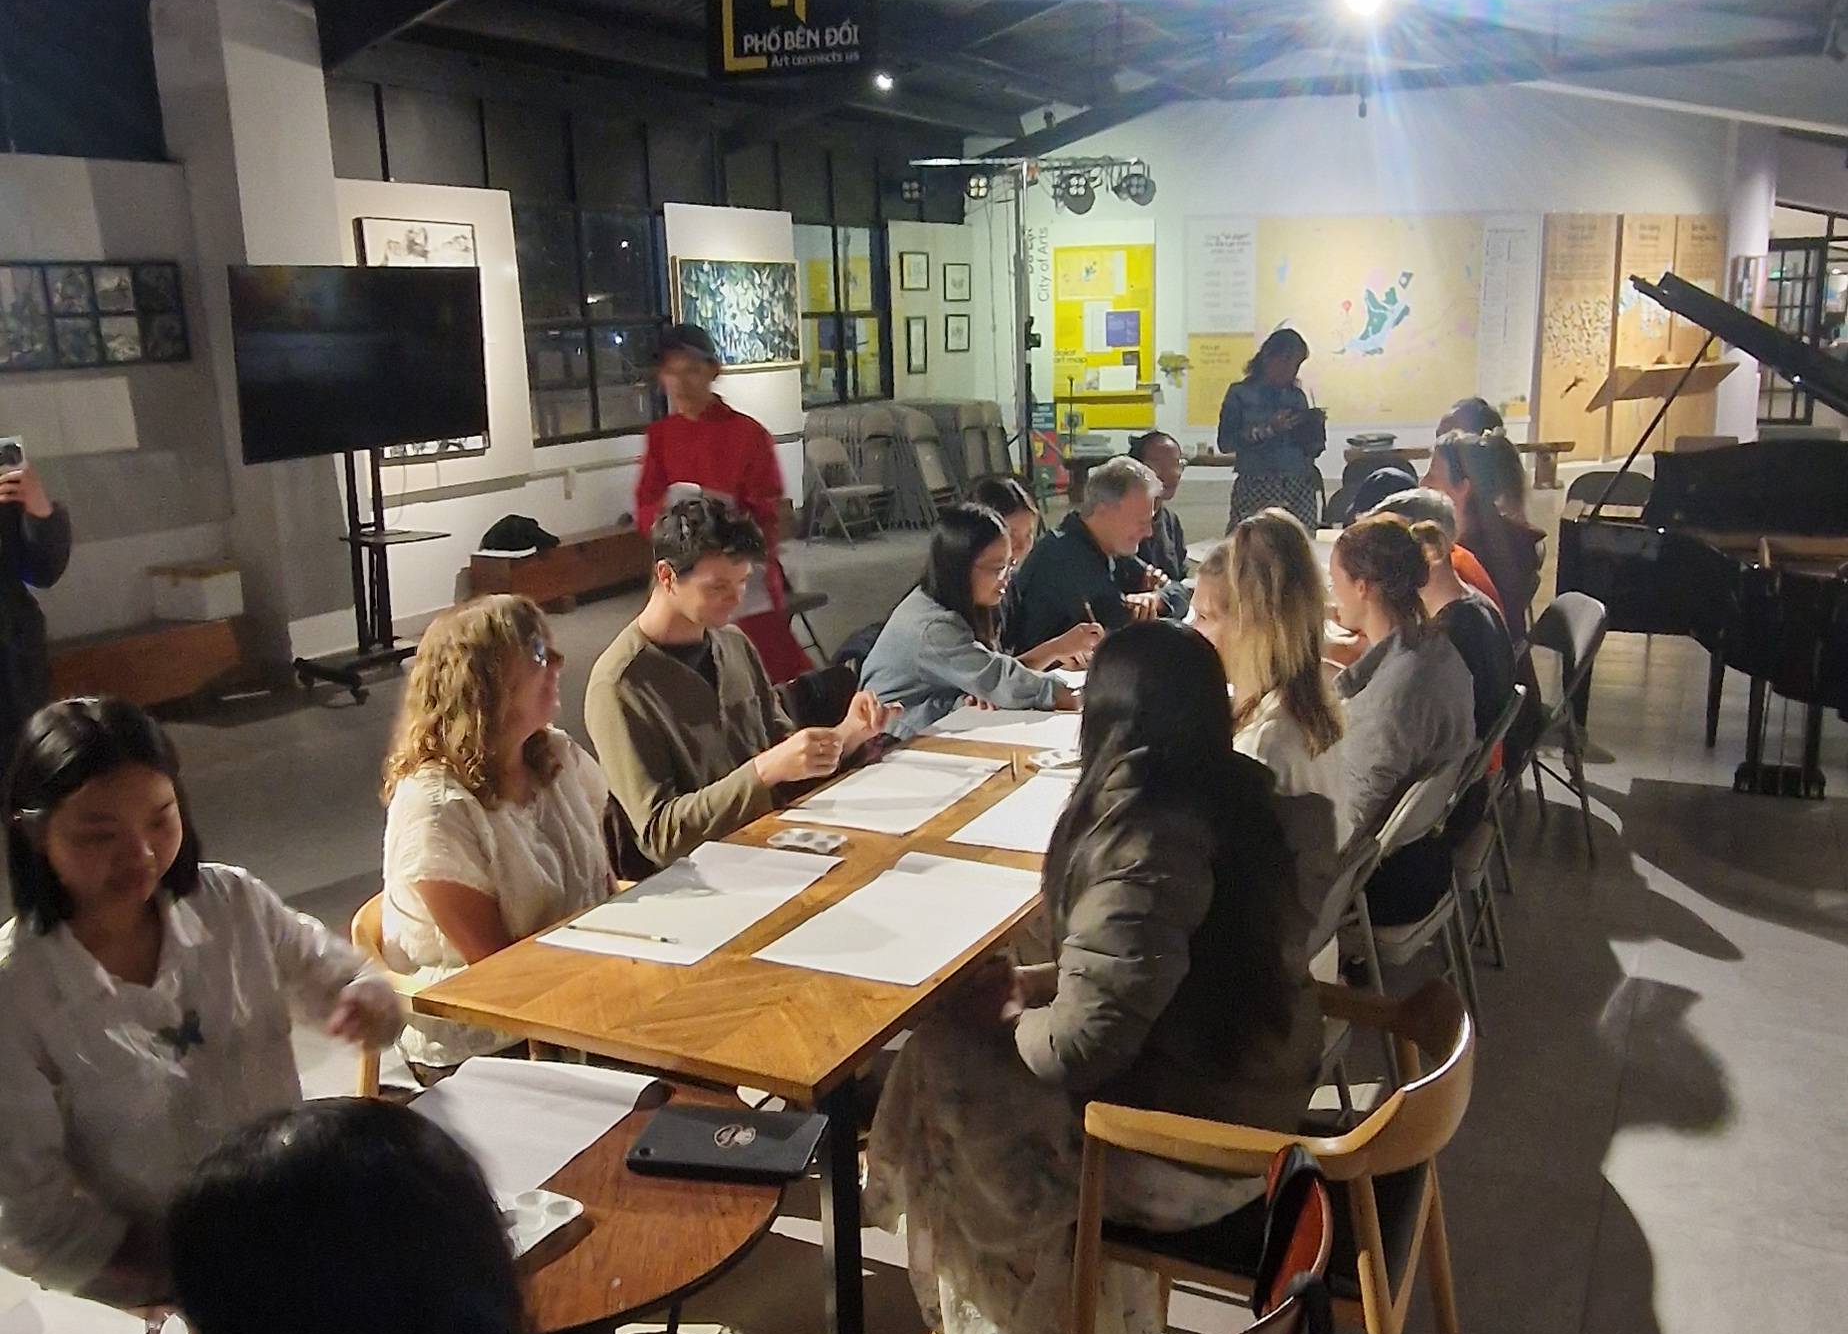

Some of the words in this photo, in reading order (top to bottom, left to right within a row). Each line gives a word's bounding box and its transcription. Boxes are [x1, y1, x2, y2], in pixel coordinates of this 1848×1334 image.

[783, 24, 820, 50] BÊN
[771, 54, 790, 67] Art
[1038, 227, 1049, 254] Arts
[1037, 259, 1049, 271] of
[1038, 275, 1051, 302] City
